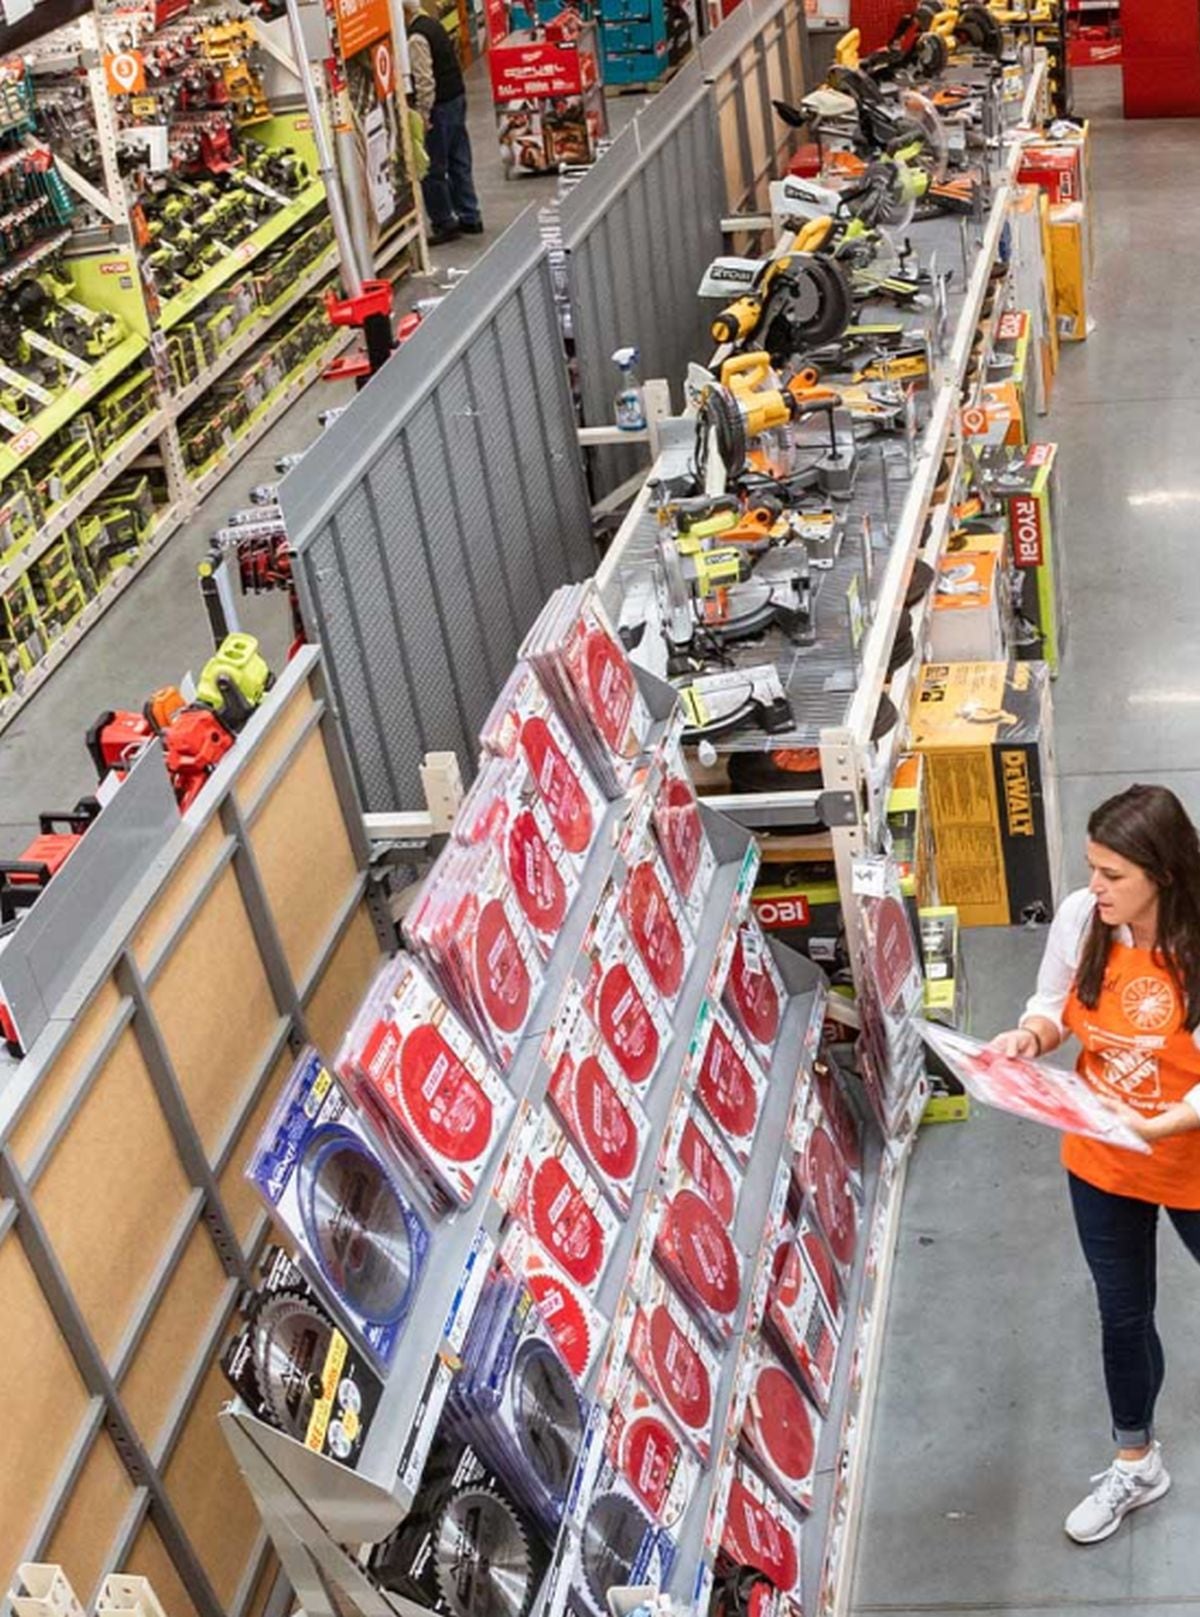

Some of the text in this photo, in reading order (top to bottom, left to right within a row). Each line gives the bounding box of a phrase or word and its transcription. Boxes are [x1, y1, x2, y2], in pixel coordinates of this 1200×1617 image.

[1016, 500, 1039, 562] RYOBI
[1001, 751, 1035, 837] DEWALT
[757, 901, 806, 924] OBI
